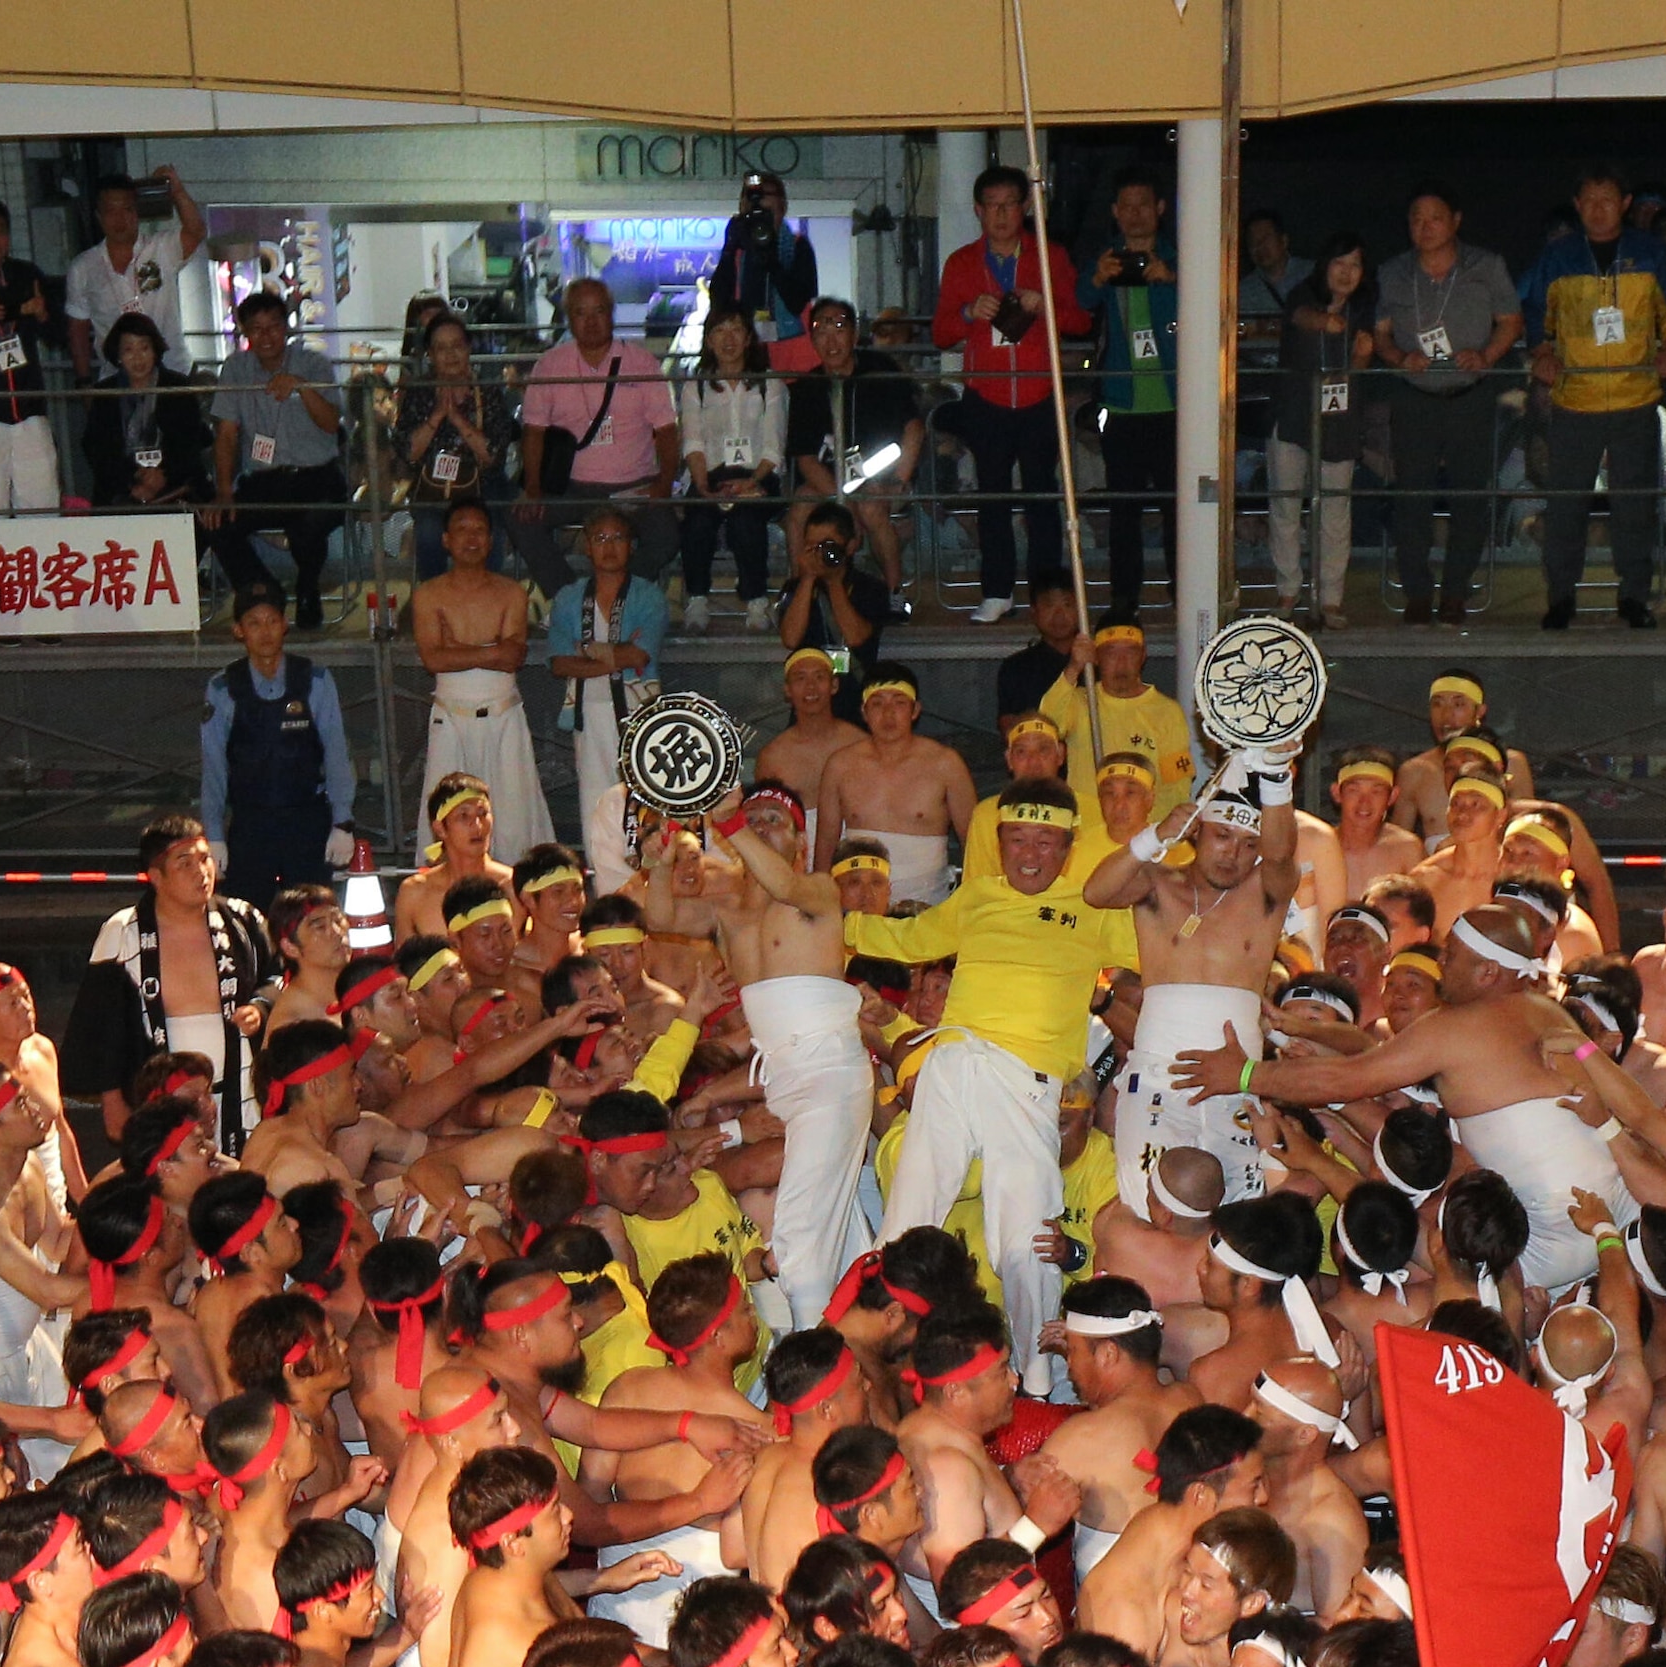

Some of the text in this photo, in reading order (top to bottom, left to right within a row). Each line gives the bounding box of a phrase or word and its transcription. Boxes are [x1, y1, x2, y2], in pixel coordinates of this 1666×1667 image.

[596, 133, 800, 175] mariko
[608, 217, 717, 241] mariko
[1129, 732, 1156, 751] 中心
[1175, 755, 1191, 773] 中
[1037, 905, 1078, 931] 審判
[1434, 1343, 1506, 1396] 419
